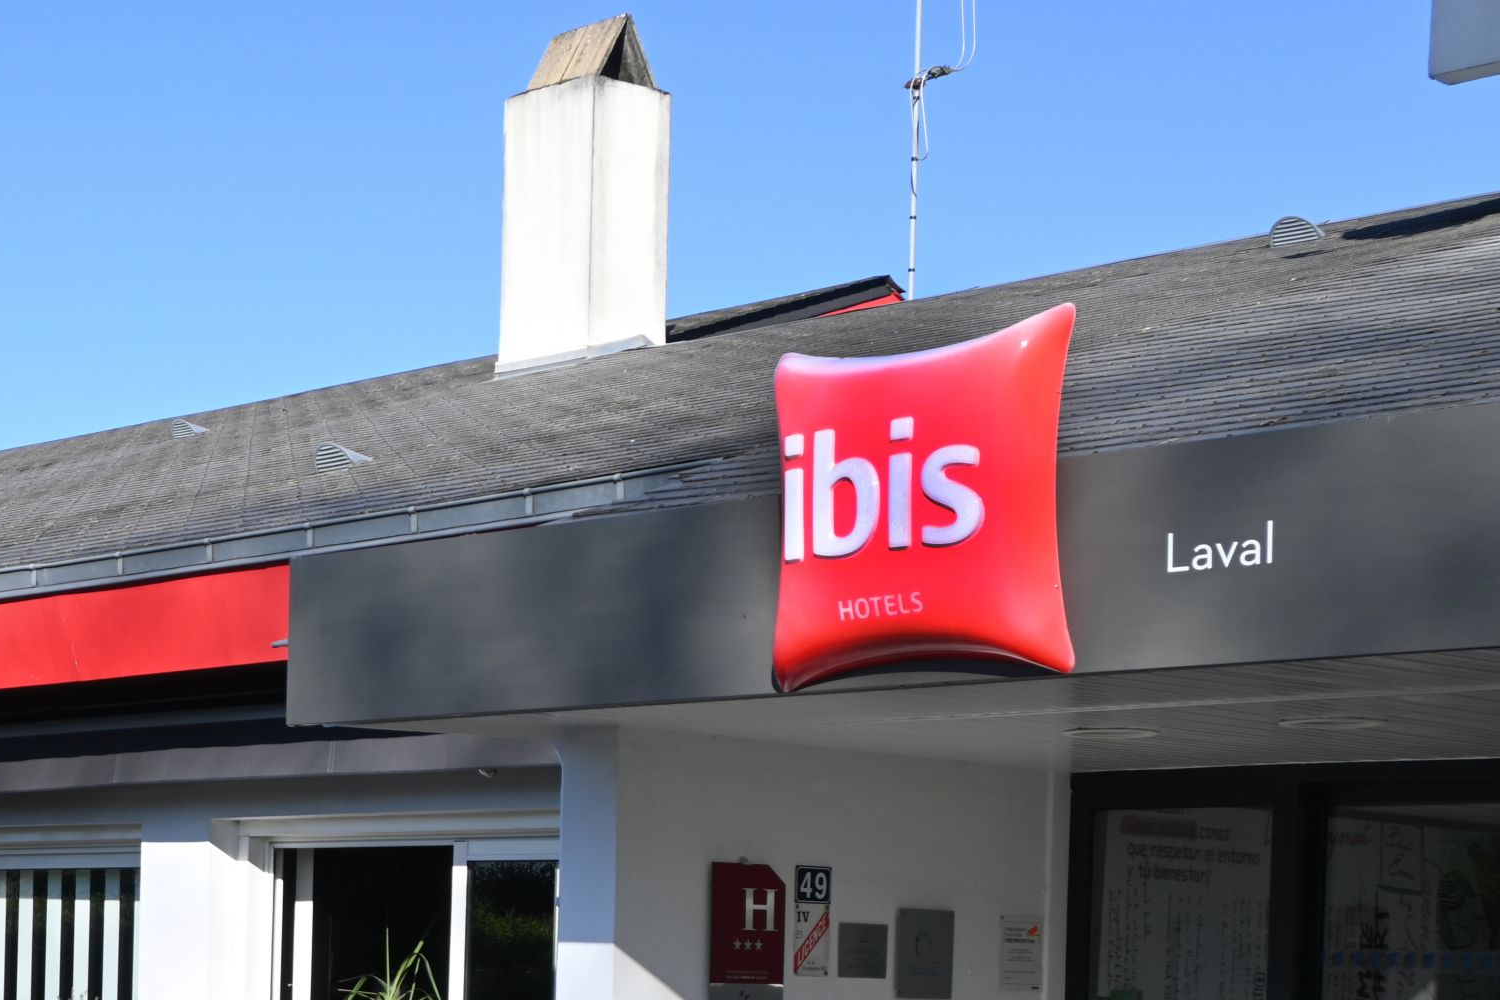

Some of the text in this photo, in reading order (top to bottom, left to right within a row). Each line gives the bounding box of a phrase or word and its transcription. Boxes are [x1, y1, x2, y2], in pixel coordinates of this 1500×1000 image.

[783, 417, 986, 562] ibis
[1167, 520, 1275, 574] Laval
[838, 591, 924, 622] HOTELS
[800, 871, 828, 900] 49
[740, 887, 780, 932] H
[796, 911, 810, 923] IV
[796, 914, 828, 966] LICENCE
